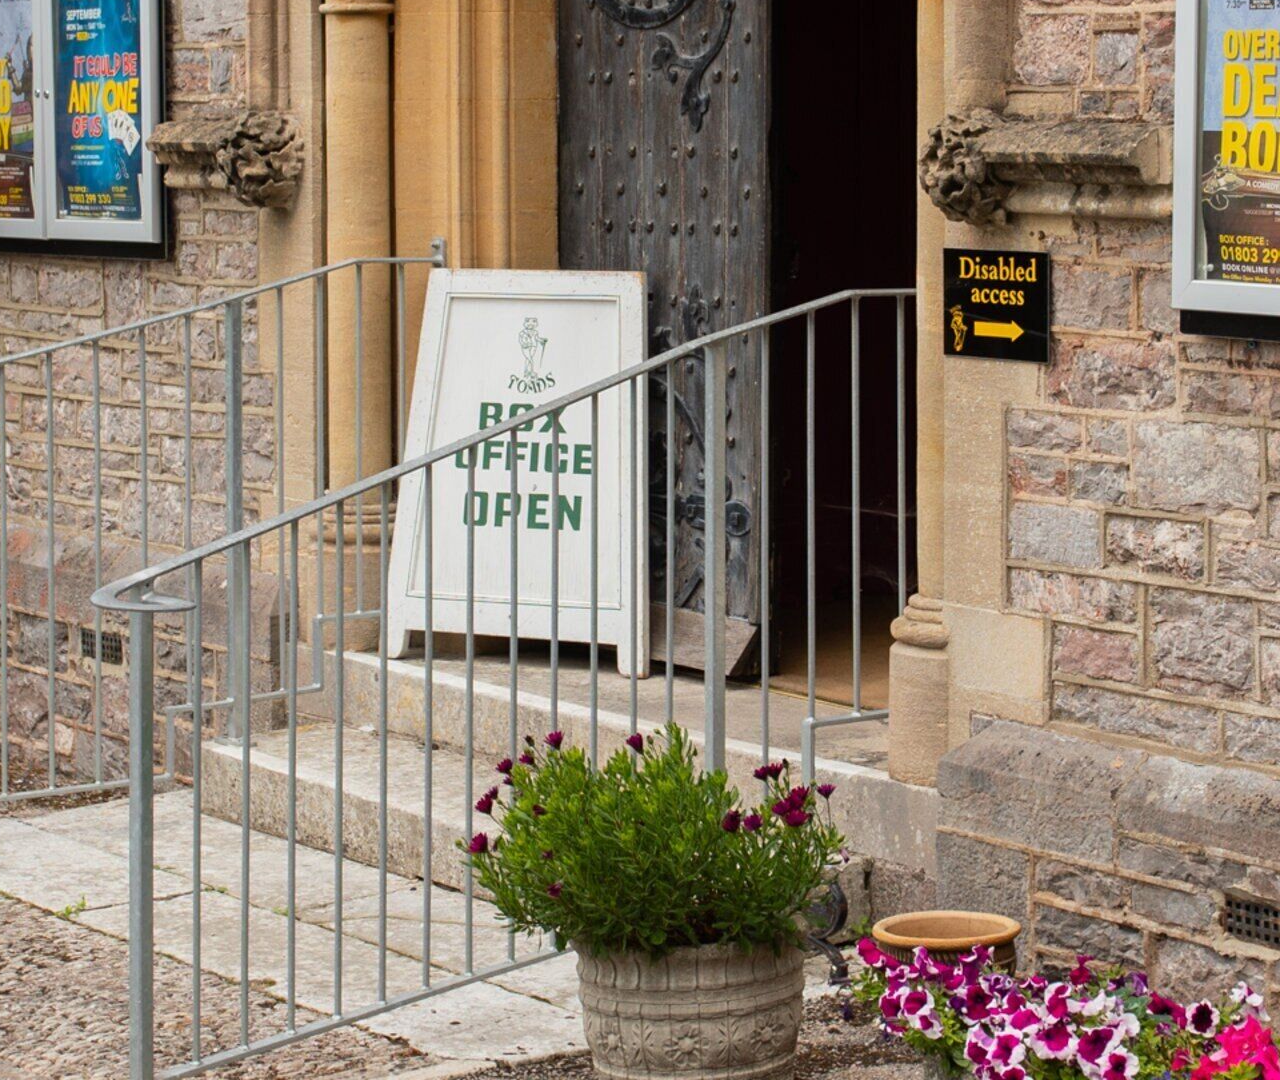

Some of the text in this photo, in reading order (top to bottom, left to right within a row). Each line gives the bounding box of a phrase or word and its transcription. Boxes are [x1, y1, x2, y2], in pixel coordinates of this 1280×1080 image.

[66, 8, 101, 21] SEPTEMBER
[74, 52, 137, 78] IT COULD BE
[68, 77, 139, 114] ANY ONE
[71, 115, 103, 139] OF US
[1253, 181, 1279, 191] COMEDY
[1219, 233, 1235, 245] BOX
[1237, 235, 1265, 246] OFFICE
[1220, 246, 1258, 262] 01803
[959, 256, 1037, 282] Disabled
[971, 287, 1025, 306] access
[508, 372, 556, 394] TOADS
[478, 402, 567, 433] BOX
[455, 440, 593, 475] OFFICE
[463, 491, 582, 531] OPEN
